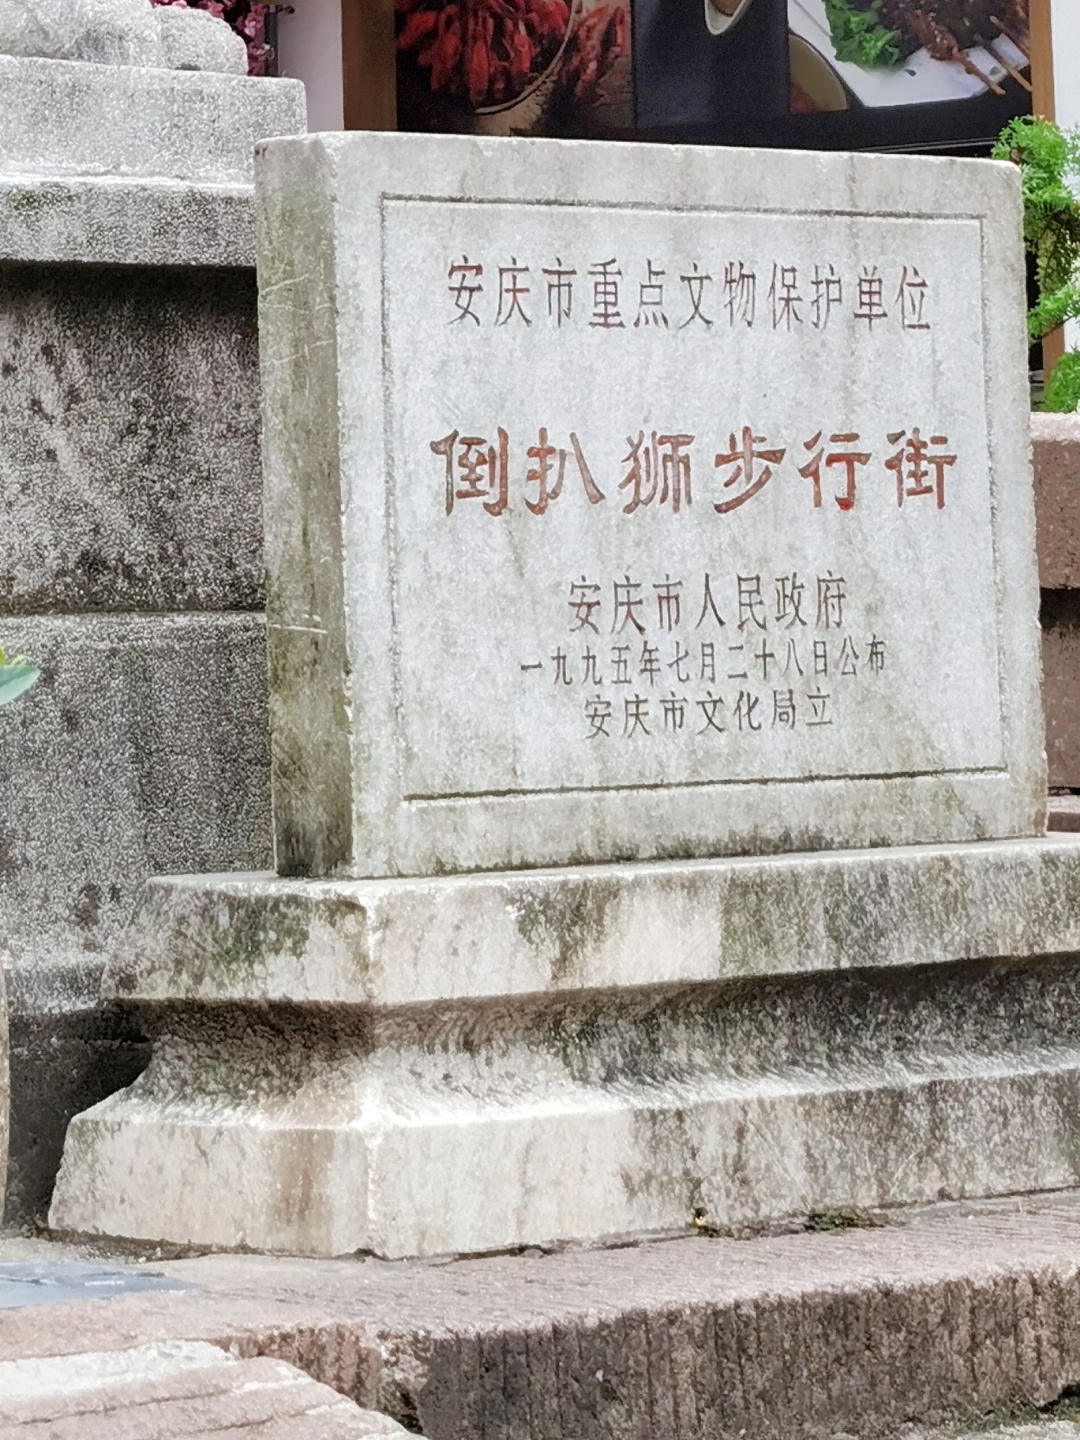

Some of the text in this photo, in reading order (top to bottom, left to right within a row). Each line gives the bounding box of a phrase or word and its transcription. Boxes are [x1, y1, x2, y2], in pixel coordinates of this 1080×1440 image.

[447, 256, 931, 330] 安庆市重点文物保护单位
[430, 426, 957, 516] 倒扒狮步行街
[568, 570, 847, 635] 安庆市人民政府
[520, 633, 887, 687] 一九九五年七月二十八日公布
[584, 688, 833, 739] 安庆市文化局立
